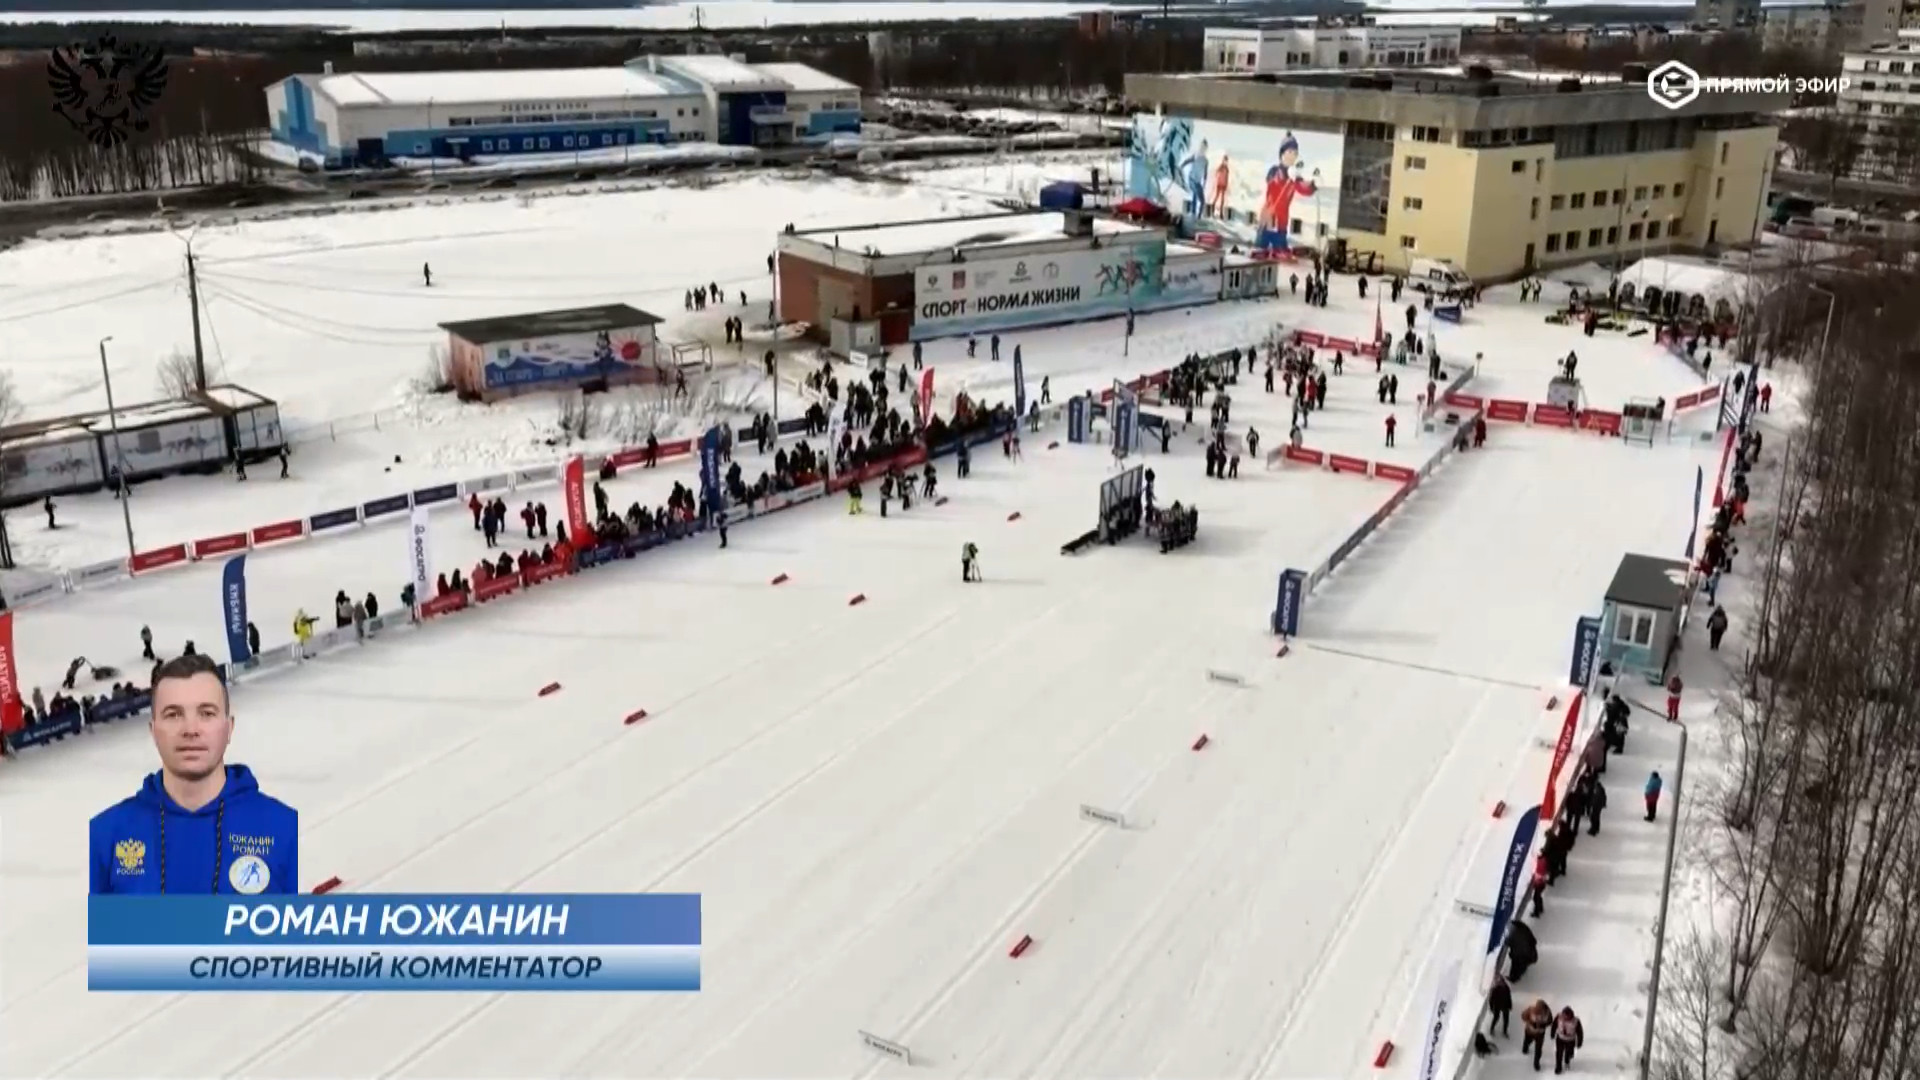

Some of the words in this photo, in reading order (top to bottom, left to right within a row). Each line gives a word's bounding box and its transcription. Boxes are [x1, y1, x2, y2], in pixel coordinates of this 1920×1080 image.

[922, 299, 968, 319] СПОРТ
[977, 290, 1030, 313] НОРМА
[1031, 285, 1081, 307] ЖИЗНИ
[229, 832, 275, 847] ЮЖАНИН
[232, 845, 270, 856] РОМАН
[116, 868, 145, 876] РОССИЯ
